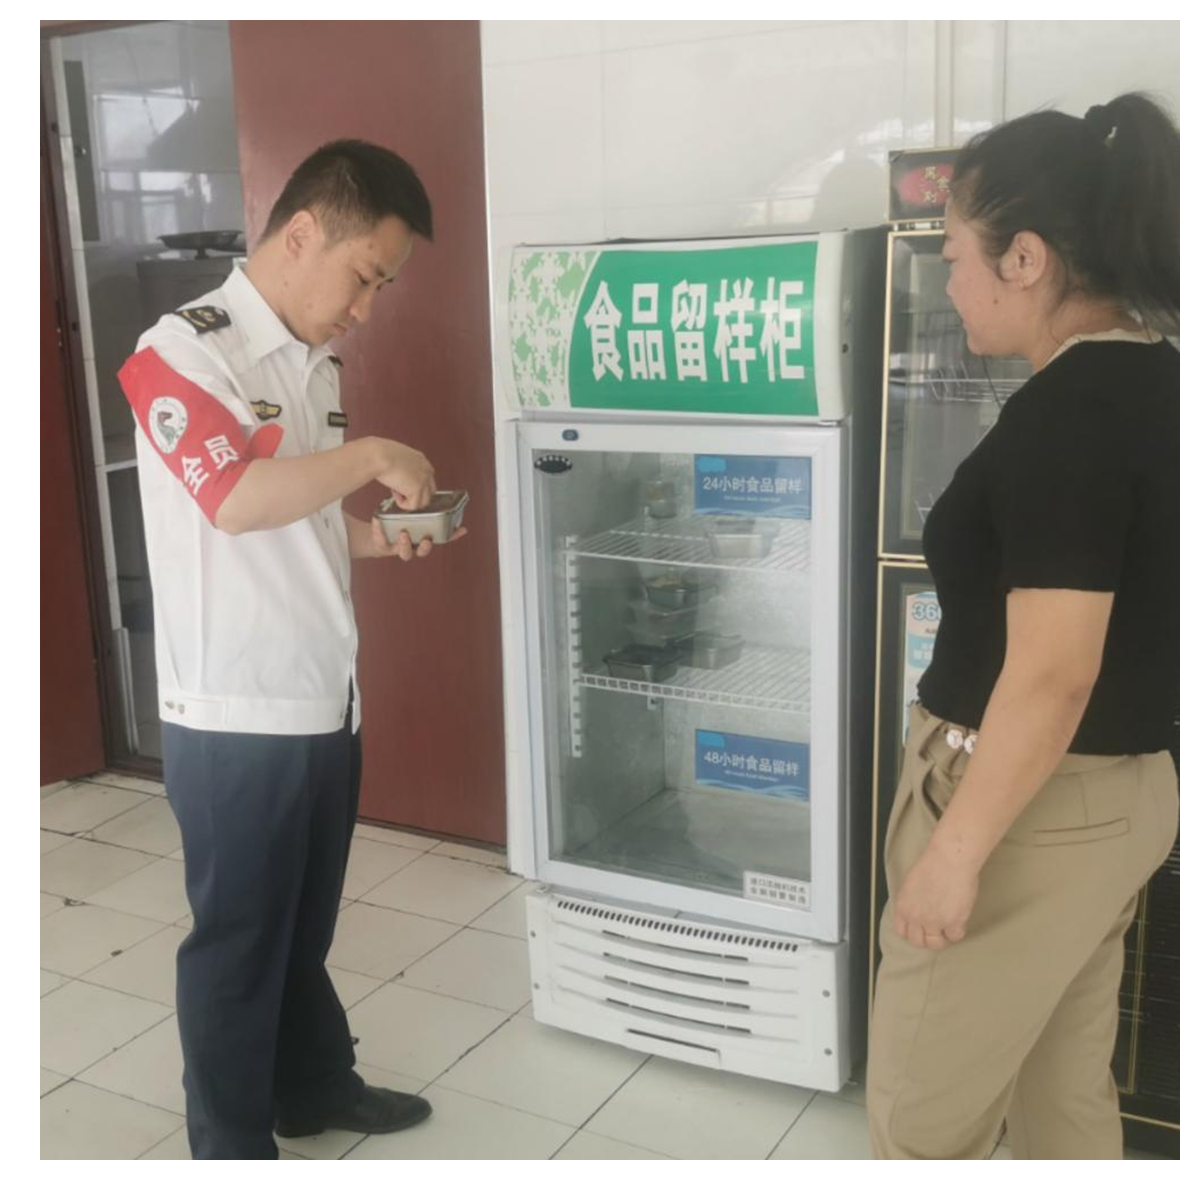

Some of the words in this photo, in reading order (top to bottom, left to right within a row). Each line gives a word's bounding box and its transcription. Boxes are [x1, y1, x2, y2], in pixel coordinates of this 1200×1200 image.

[583, 276, 806, 383] 食品留样柜
[703, 475, 803, 495] 24小时食品留样
[703, 751, 800, 777] 48小时食品留样
